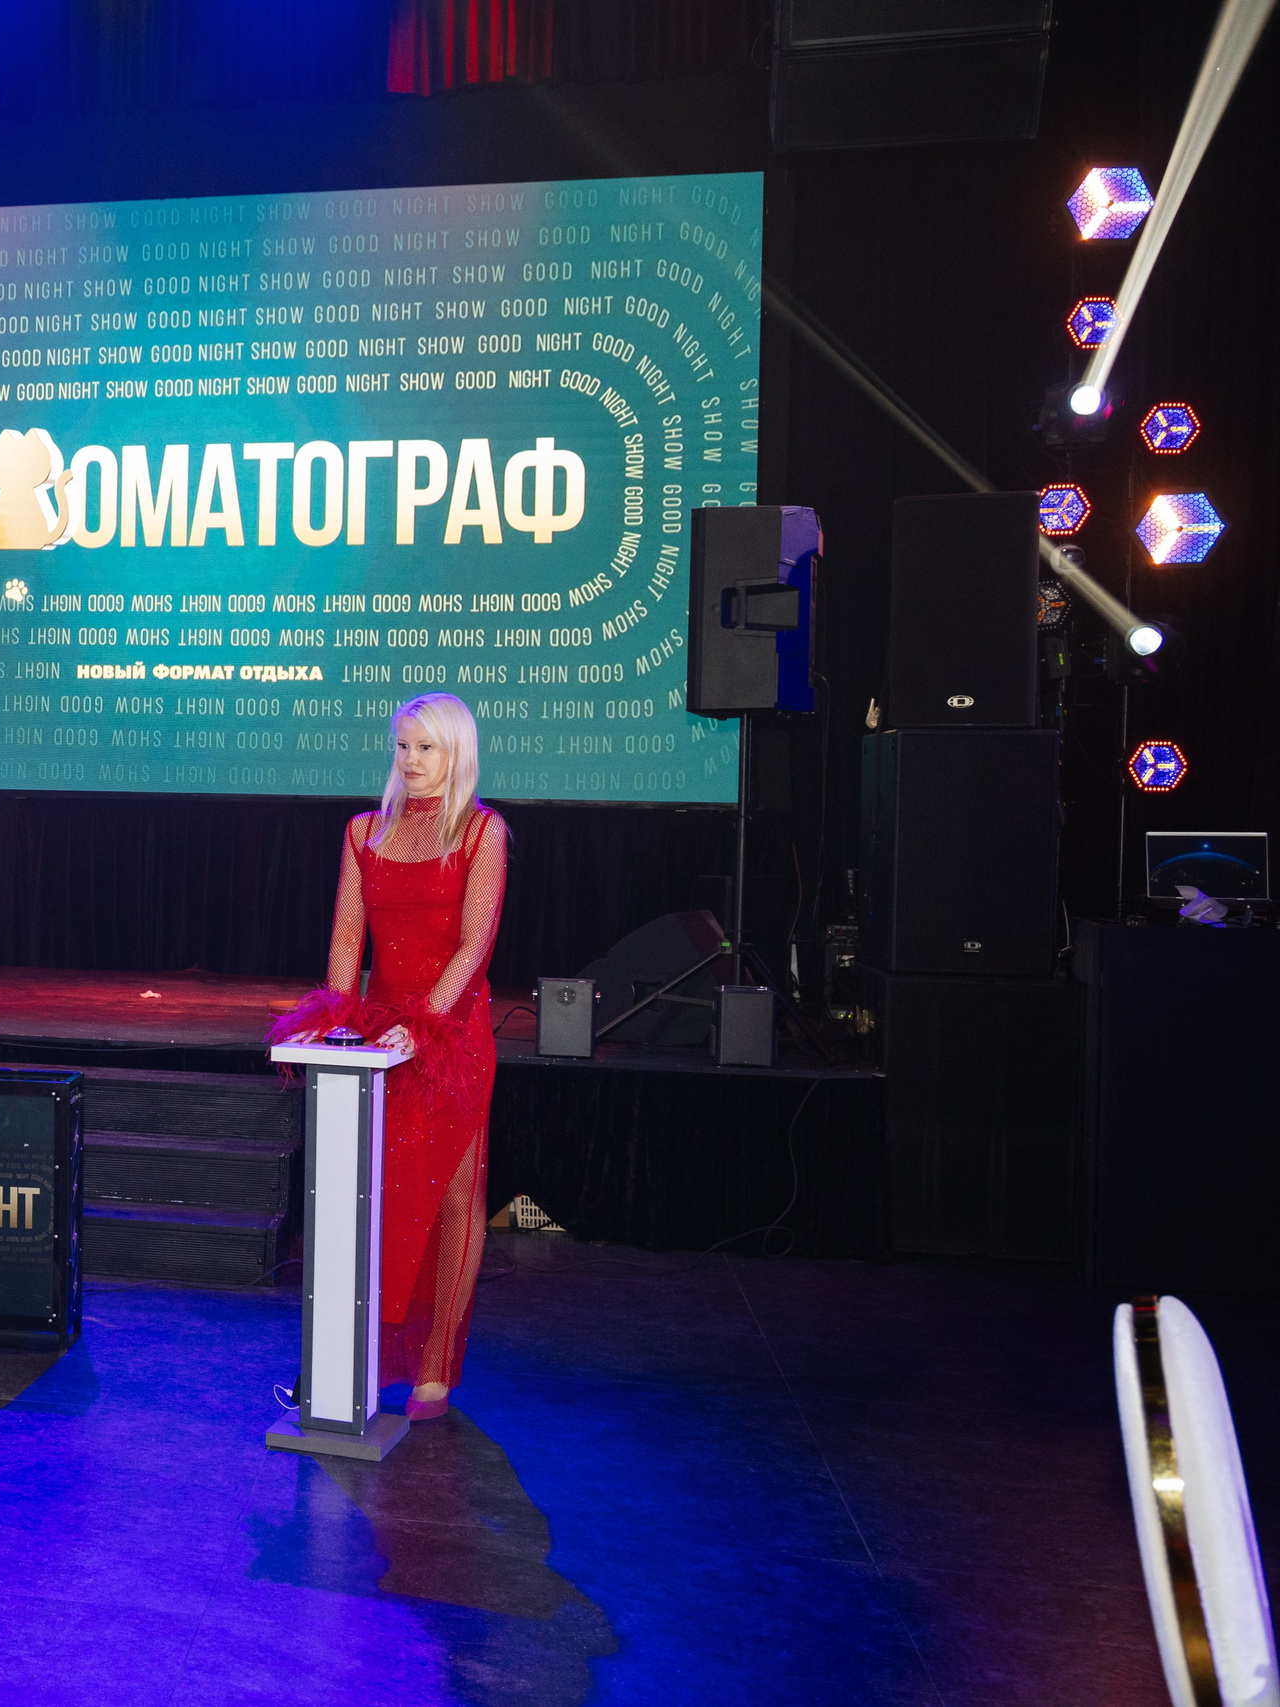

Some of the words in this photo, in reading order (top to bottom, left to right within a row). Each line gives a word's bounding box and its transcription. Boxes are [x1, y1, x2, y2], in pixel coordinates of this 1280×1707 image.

[539, 226, 590, 245] GOOD
[611, 223, 664, 242] NIGHT
[680, 220, 728, 260] GOOD
[251, 341, 297, 360] SHOW
[306, 339, 348, 358] GOOD
[359, 337, 406, 356] NIGHT
[418, 336, 464, 355] SHOW
[478, 334, 521, 353] GOOD
[536, 332, 582, 351] NIGHT
[592, 332, 635, 362] GOOD
[2, 349, 41, 367] GOOD
[25, 281, 73, 299] NIGHT
[84, 279, 132, 297] SHOW
[144, 276, 190, 295] GOOD
[199, 274, 250, 292] NIGHT
[260, 272, 310, 291] SHOW
[323, 269, 370, 288] GOOD
[385, 267, 437, 286] NIGHT
[453, 265, 505, 284] SHOW
[523, 262, 572, 281] GOOD
[591, 259, 643, 279] NIGHT
[657, 259, 703, 294] GOOD
[708, 290, 753, 360] NIGHT
[740, 378, 759, 454] SHOW
[47, 347, 91, 365] NIGHT
[98, 346, 142, 364] SHOW
[151, 344, 192, 363] GOOD
[198, 342, 244, 361] NIGHT
[36, 314, 82, 332] NIGHT
[91, 312, 137, 331] SHOW
[147, 310, 191, 329] GOOD
[199, 308, 247, 327] NIGHT
[256, 307, 304, 325] SHOW
[314, 304, 359, 323] GOOD
[372, 302, 422, 321] NIGHT
[436, 301, 485, 319] SHOW
[501, 298, 547, 317] GOOD
[564, 296, 613, 315] NIGHT
[625, 296, 670, 328] GOOD
[673, 323, 714, 382] NIGHT
[701, 396, 723, 462] SHOW
[198, 377, 241, 396] NIGHT
[247, 377, 290, 395] SHOW
[297, 375, 337, 394] GOOD
[346, 373, 390, 392] NIGHT
[400, 372, 444, 391] SHOW
[455, 371, 496, 390] GOOD
[509, 369, 551, 388] NIGHT
[560, 369, 601, 396] GOOD
[636, 355, 676, 405] NIGHT
[17, 383, 54, 401] GOOD
[58, 381, 100, 400] NIGHT
[106, 381, 148, 399] SHOW
[154, 379, 193, 397] GOOD
[599, 387, 638, 428] NIGHT
[663, 415, 683, 470] SHOW
[624, 433, 644, 479] SHOW
[624, 486, 643, 526] GOOD
[662, 484, 682, 533] GOOD
[610, 532, 641, 577] NIGHT
[648, 544, 680, 602] NIGHT
[569, 573, 612, 607] SHOW
[42, 594, 81, 612] NIGHT
[88, 594, 124, 612] GOOD
[131, 594, 173, 612] SHOW
[180, 594, 221, 612] NIGHT
[228, 594, 266, 612] GOOD
[273, 594, 315, 612] SHOW
[323, 594, 365, 612] NIGHT
[373, 594, 411, 612] GOOD
[419, 594, 462, 612] SHOW
[471, 594, 514, 612] NIGHT
[521, 593, 561, 612] GOOD
[602, 600, 648, 641] SHOW
[28, 628, 70, 645] NIGHT
[78, 628, 117, 645] GOOD
[126, 628, 169, 646] SHOW
[178, 628, 222, 646] NIGHT
[230, 629, 270, 646] GOOD
[279, 629, 324, 647] SHOW
[334, 629, 379, 647] NIGHT
[387, 629, 428, 647] GOOD
[438, 629, 484, 647] SHOW
[494, 629, 541, 647] NIGHT
[550, 627, 592, 647] GOOD
[636, 629, 683, 676] SHOW
[15, 662, 60, 679] NIGHT
[77, 662, 145, 679] НОВЫЙ
[153, 664, 234, 680] ФОРМАТ
[240, 666, 323, 682] ОТДЫХА
[342, 665, 390, 683] NIGHT
[403, 665, 446, 683] GOOD
[458, 665, 507, 683] SHOW
[518, 665, 568, 683] NIGHT
[578, 663, 623, 683] GOOD
[3, 695, 50, 712] NIGHT
[60, 696, 103, 713] GOOD
[115, 697, 163, 715] SHOW
[175, 698, 224, 715] NIGHT
[236, 698, 279, 716] GOOD
[292, 699, 343, 717] SHOW
[477, 701, 528, 719] SHOW
[541, 701, 593, 719] NIGHT
[606, 699, 653, 719] GOOD
